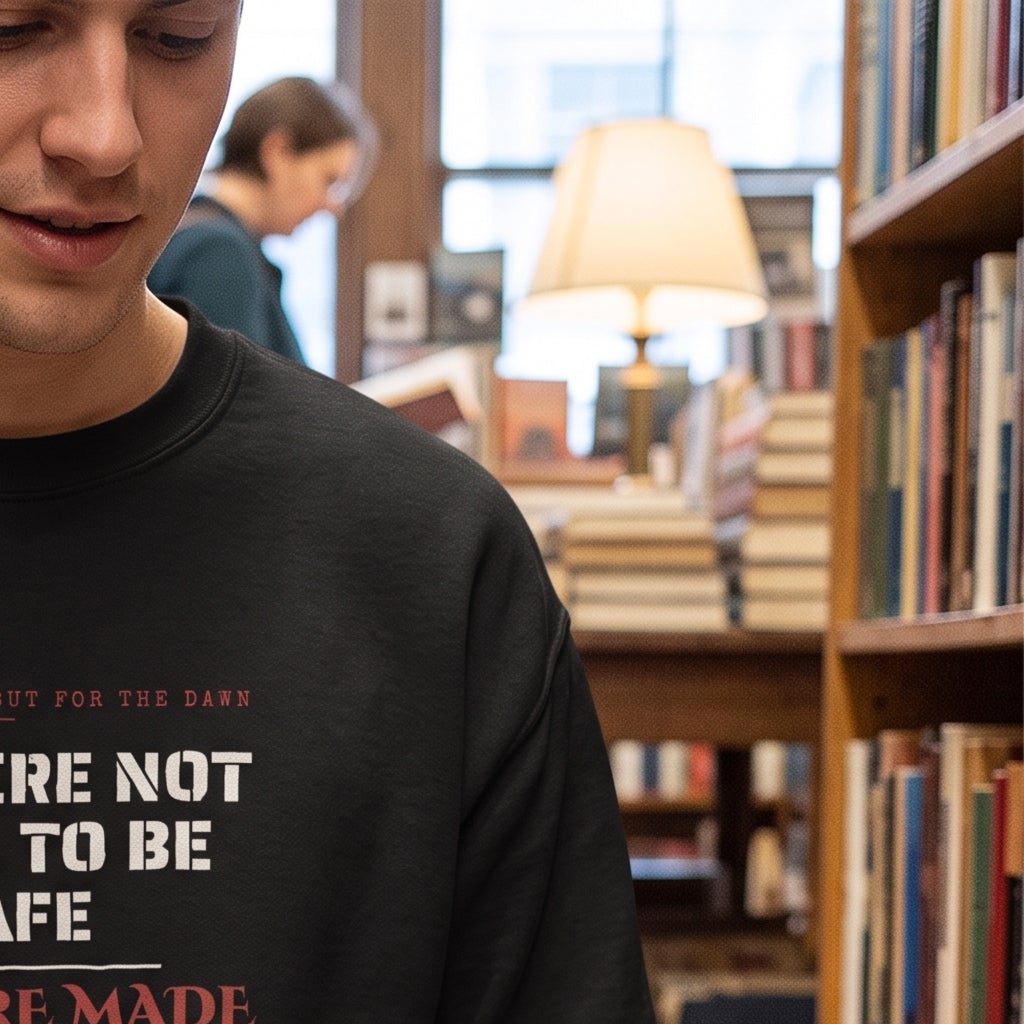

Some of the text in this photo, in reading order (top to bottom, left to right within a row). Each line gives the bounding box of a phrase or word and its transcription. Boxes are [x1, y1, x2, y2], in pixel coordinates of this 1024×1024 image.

[55, 690, 103, 708] FOR
[119, 690, 168, 707] THE
[184, 689, 250, 707] DAWN
[115, 749, 253, 803] NOT
[19, 820, 107, 874] TO
[128, 819, 212, 872] BE
